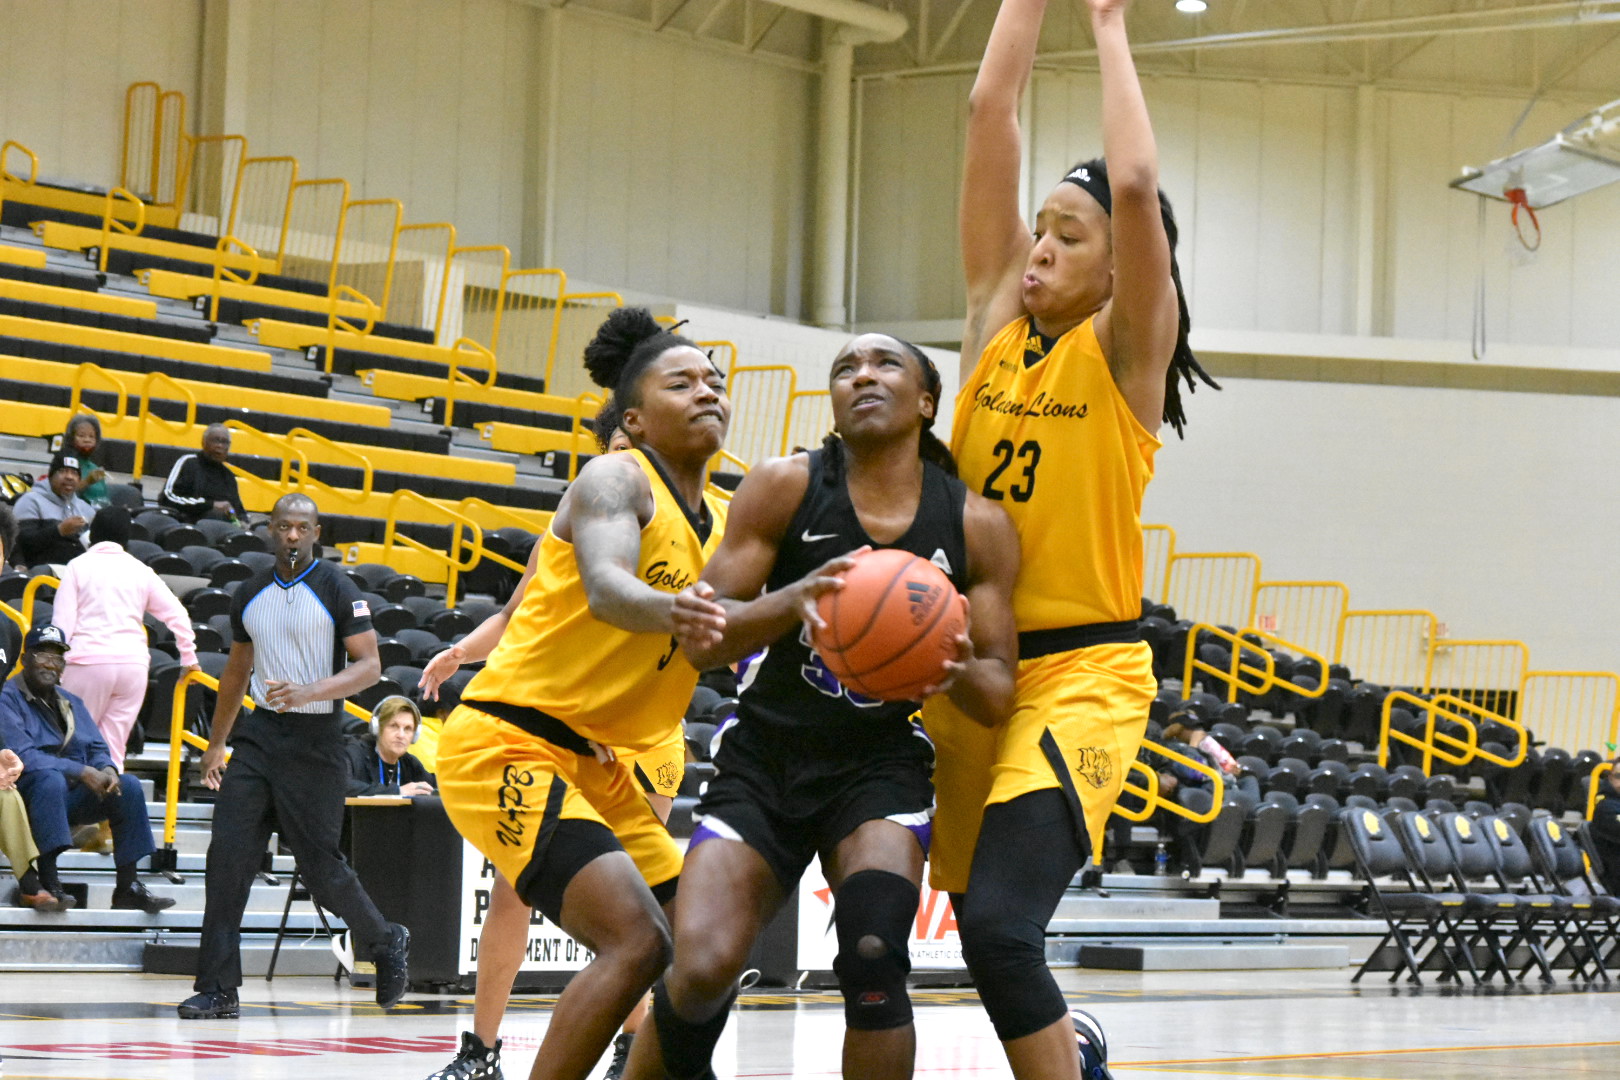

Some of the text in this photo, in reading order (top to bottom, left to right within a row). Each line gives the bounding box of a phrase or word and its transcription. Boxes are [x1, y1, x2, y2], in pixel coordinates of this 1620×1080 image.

[1024, 391, 1089, 418] Lions
[981, 438, 1042, 503] 23
[565, 937, 580, 962] OF
[917, 950, 951, 959] ATHLETIC
